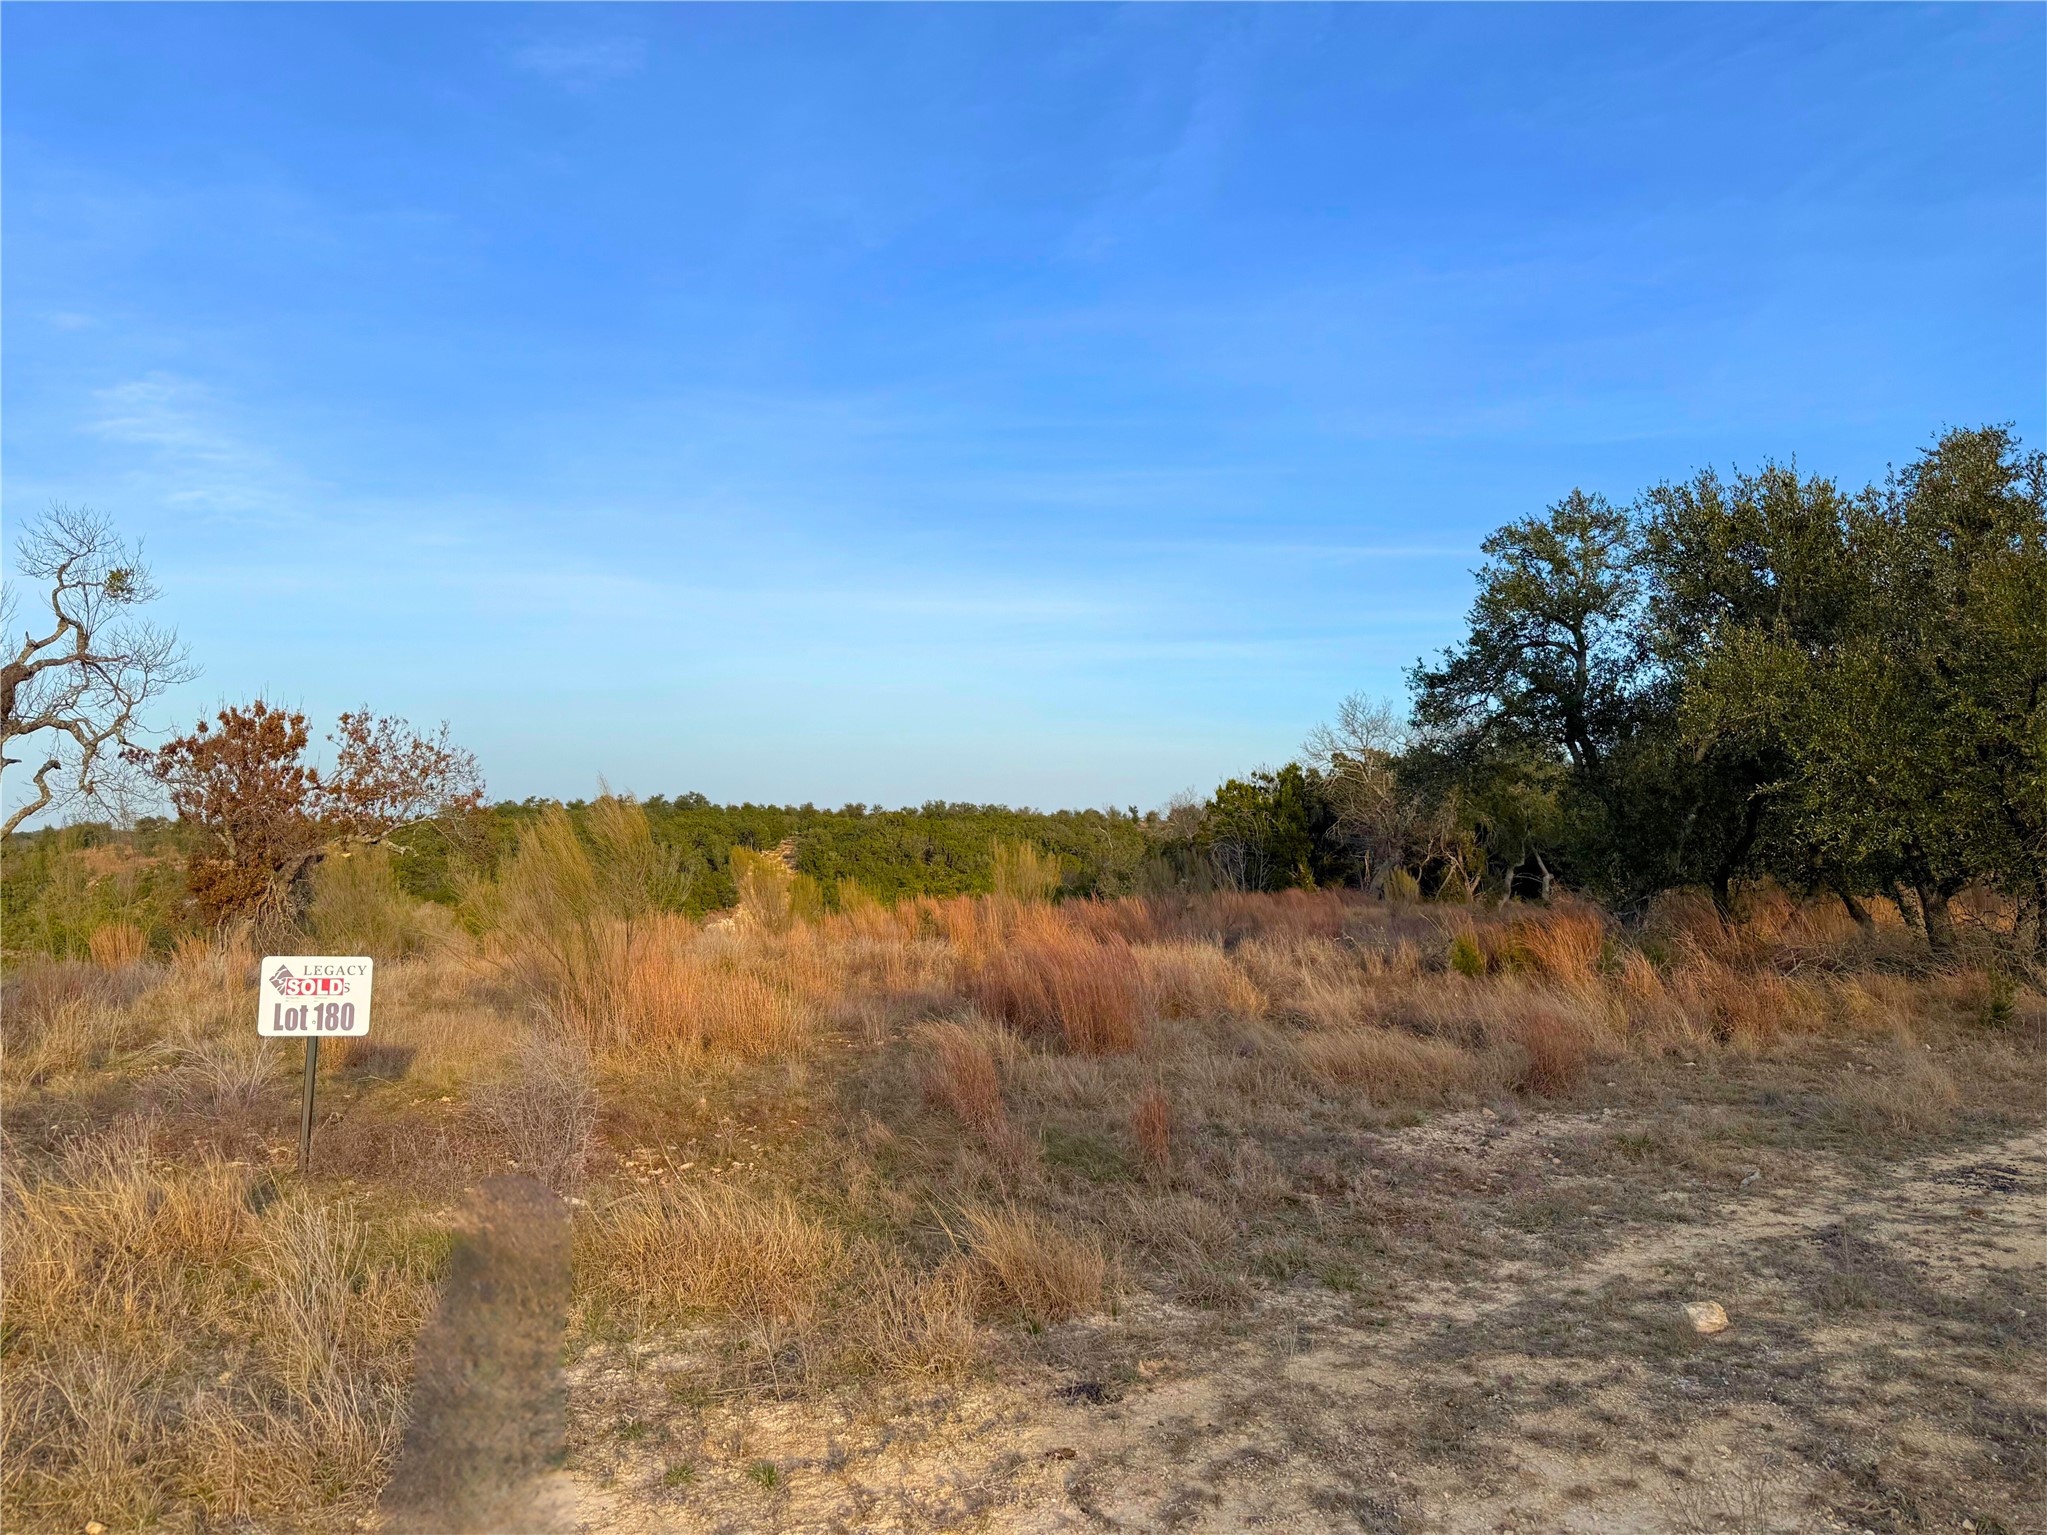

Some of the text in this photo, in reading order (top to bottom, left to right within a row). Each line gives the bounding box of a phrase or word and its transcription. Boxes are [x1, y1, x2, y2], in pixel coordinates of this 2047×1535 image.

[303, 965, 367, 976] LEGACY
[286, 978, 343, 995] SOLD
[273, 1002, 355, 1031] Lot 180
